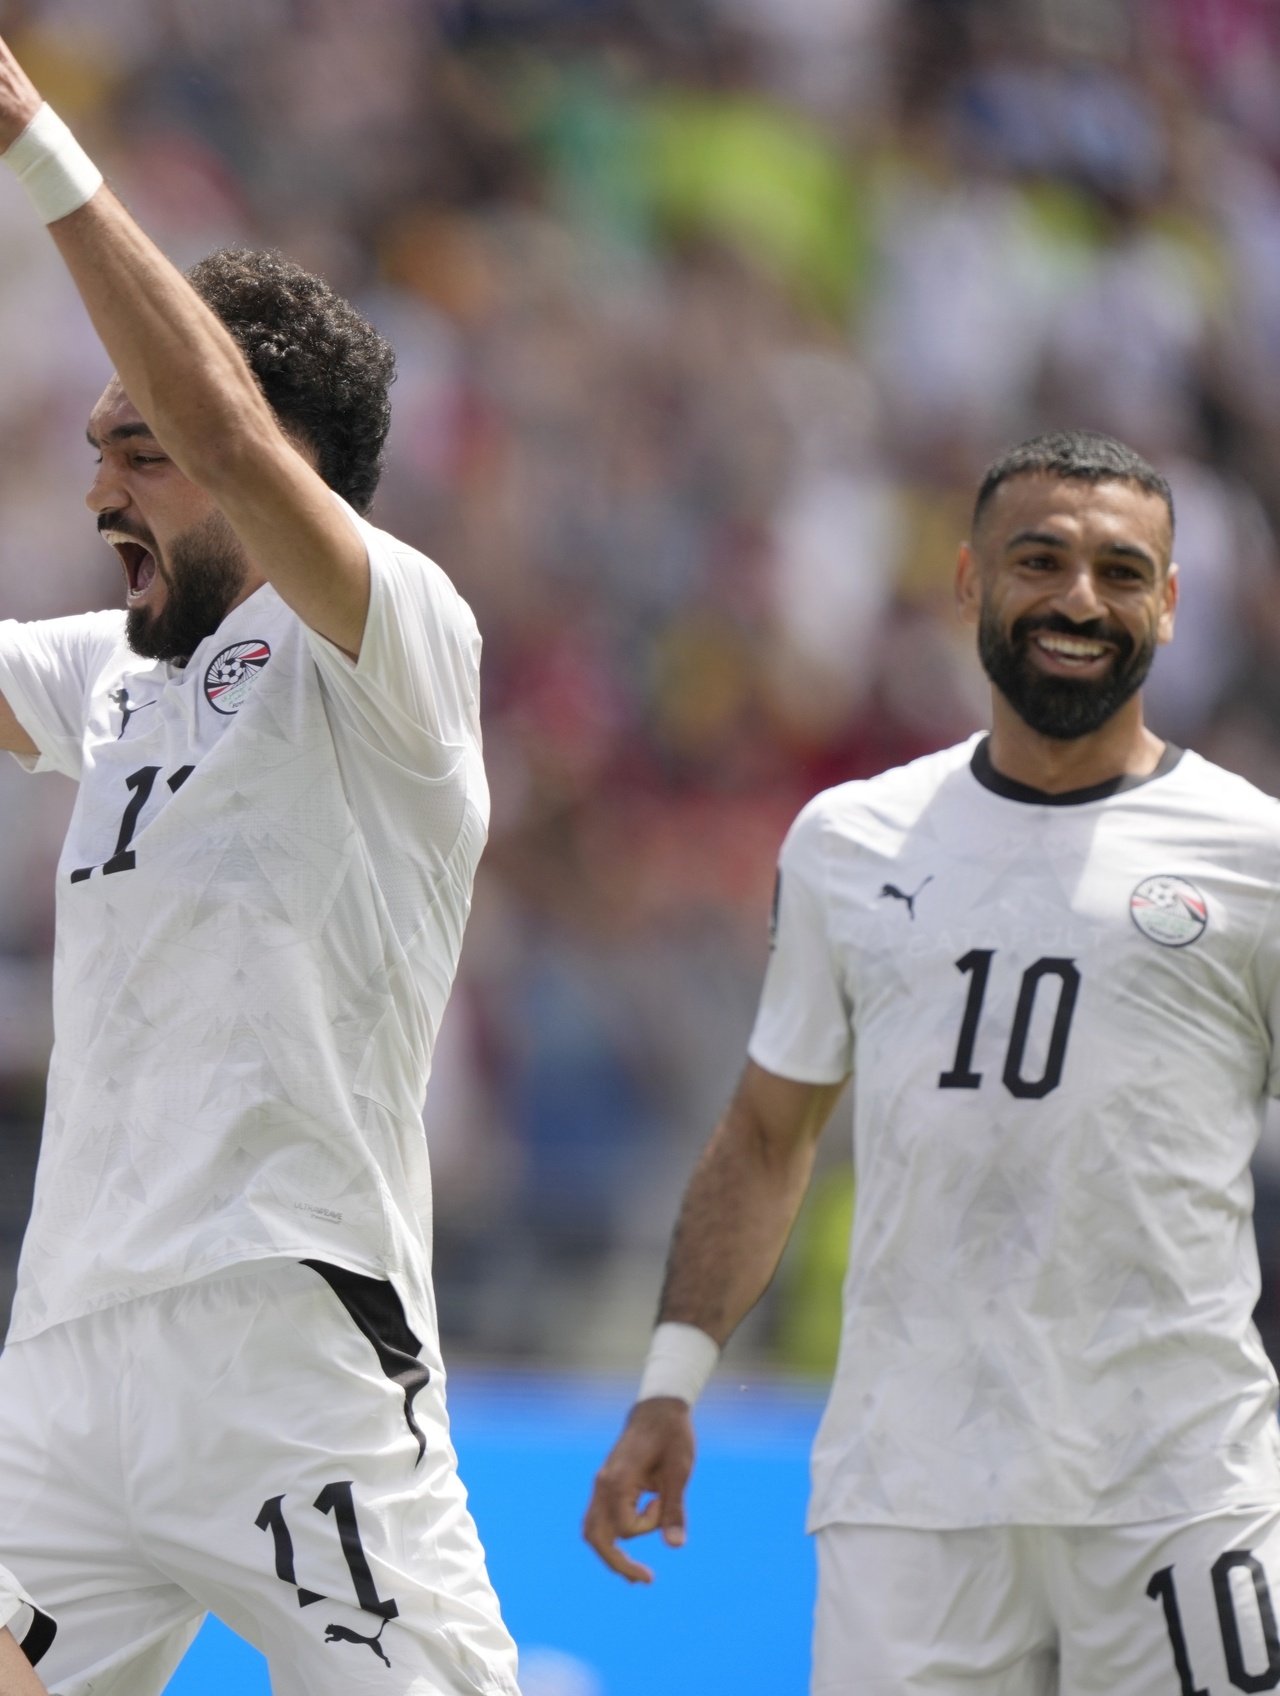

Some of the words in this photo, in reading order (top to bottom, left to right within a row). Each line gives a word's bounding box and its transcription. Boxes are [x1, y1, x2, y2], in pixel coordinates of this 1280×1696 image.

[71, 765, 197, 884] 1
[938, 949, 1081, 1100] 10
[254, 1481, 399, 1621] 11
[1146, 1548, 1280, 1696] 10
